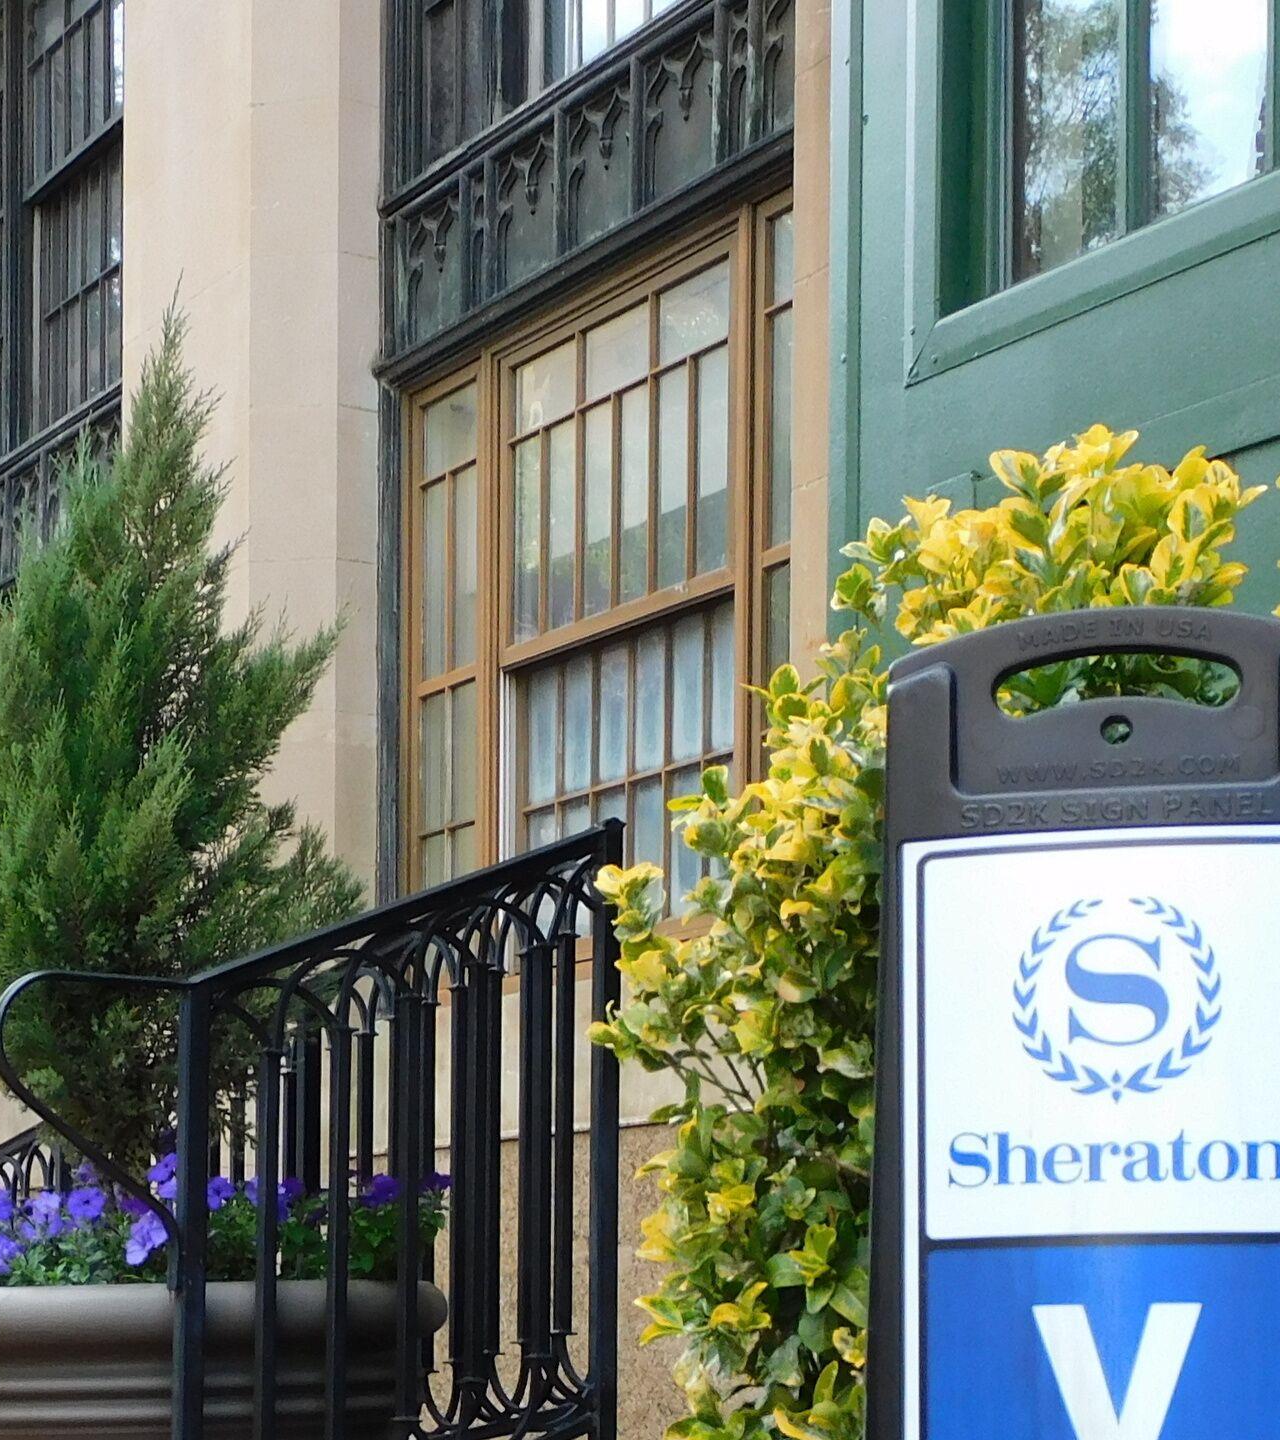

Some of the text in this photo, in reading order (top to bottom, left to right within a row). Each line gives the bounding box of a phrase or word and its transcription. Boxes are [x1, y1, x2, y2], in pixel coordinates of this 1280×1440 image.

[1016, 616, 1213, 651] MADE IN USA
[959, 790, 1275, 830] SD2K SIGN PANEL
[1064, 933, 1170, 1047] S
